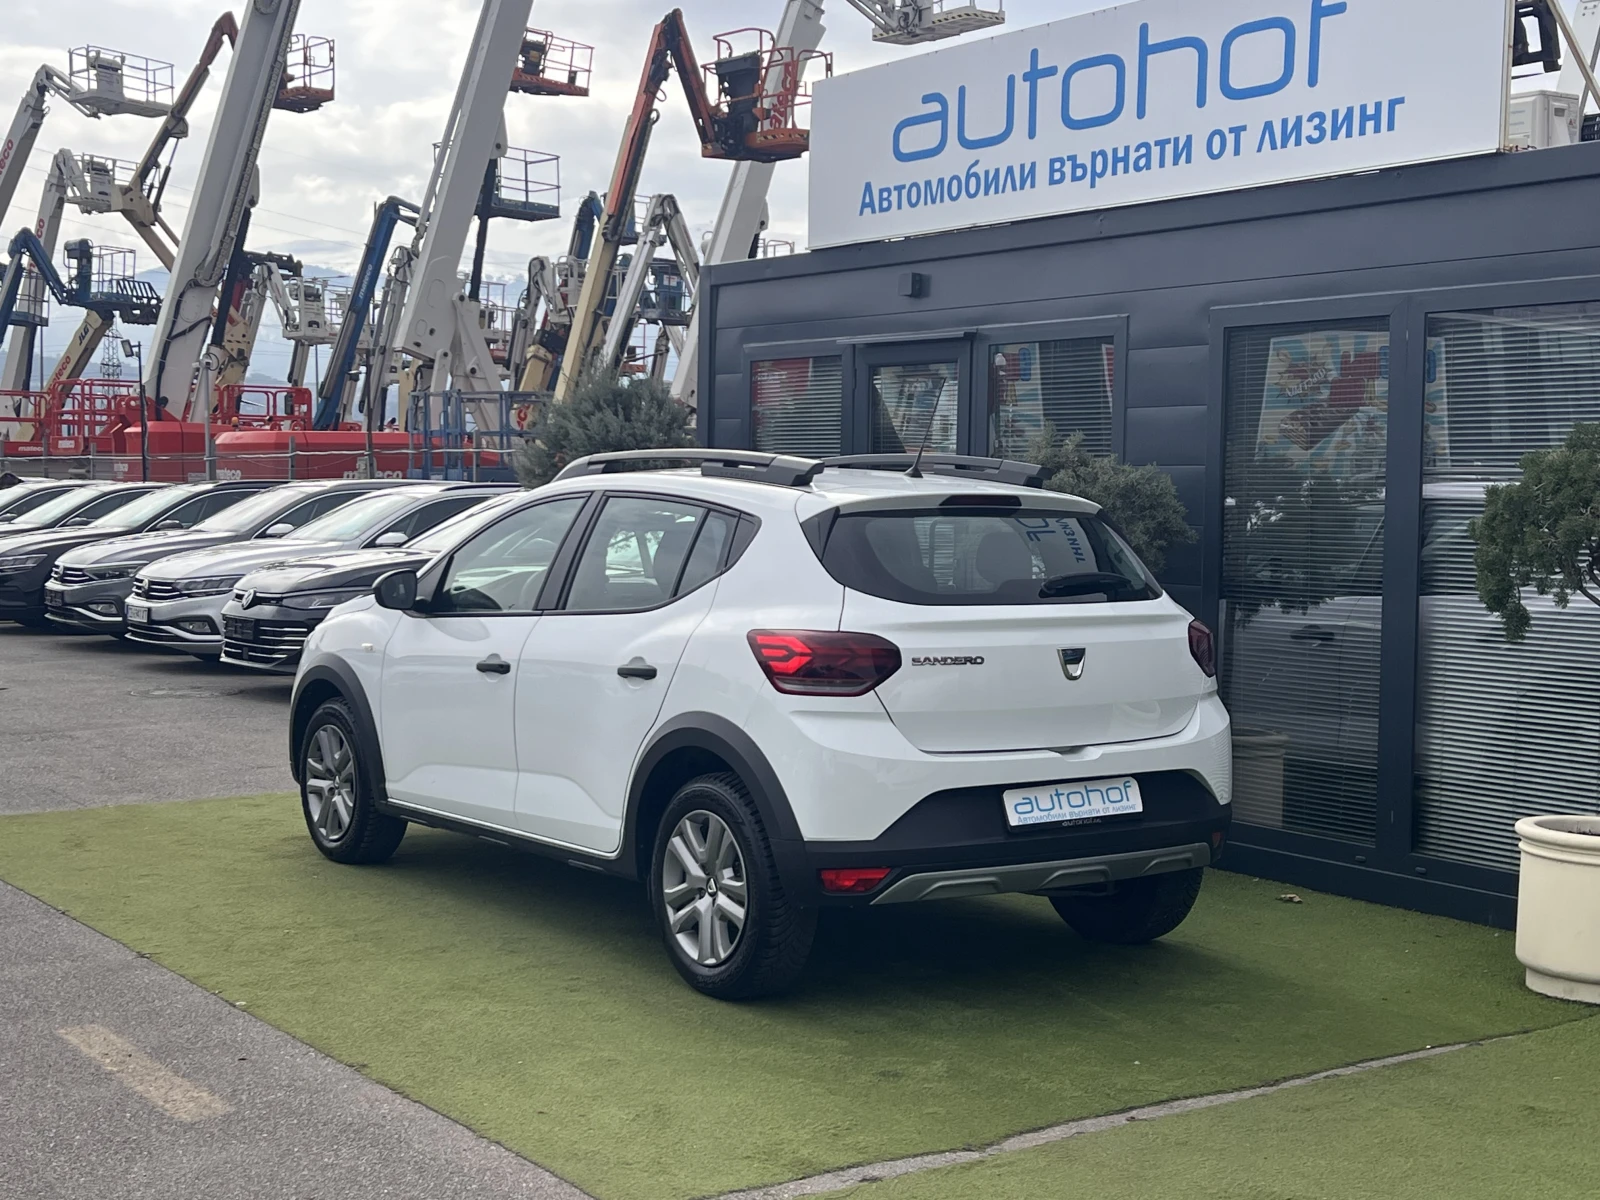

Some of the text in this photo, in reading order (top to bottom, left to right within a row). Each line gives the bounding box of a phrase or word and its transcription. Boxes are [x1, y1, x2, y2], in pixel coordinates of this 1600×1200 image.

[893, 0, 1347, 163] autohof
[859, 96, 1406, 216] Автомобили върнати от лизинг
[358, 263, 373, 299] mateco
[78, 323, 90, 347] JLG
[911, 655, 985, 667] SANDERO
[1014, 781, 1132, 814] autohof
[1017, 811, 1067, 825] Автомобили
[1069, 807, 1101, 819] върнати
[1112, 803, 1137, 814] лизинг
